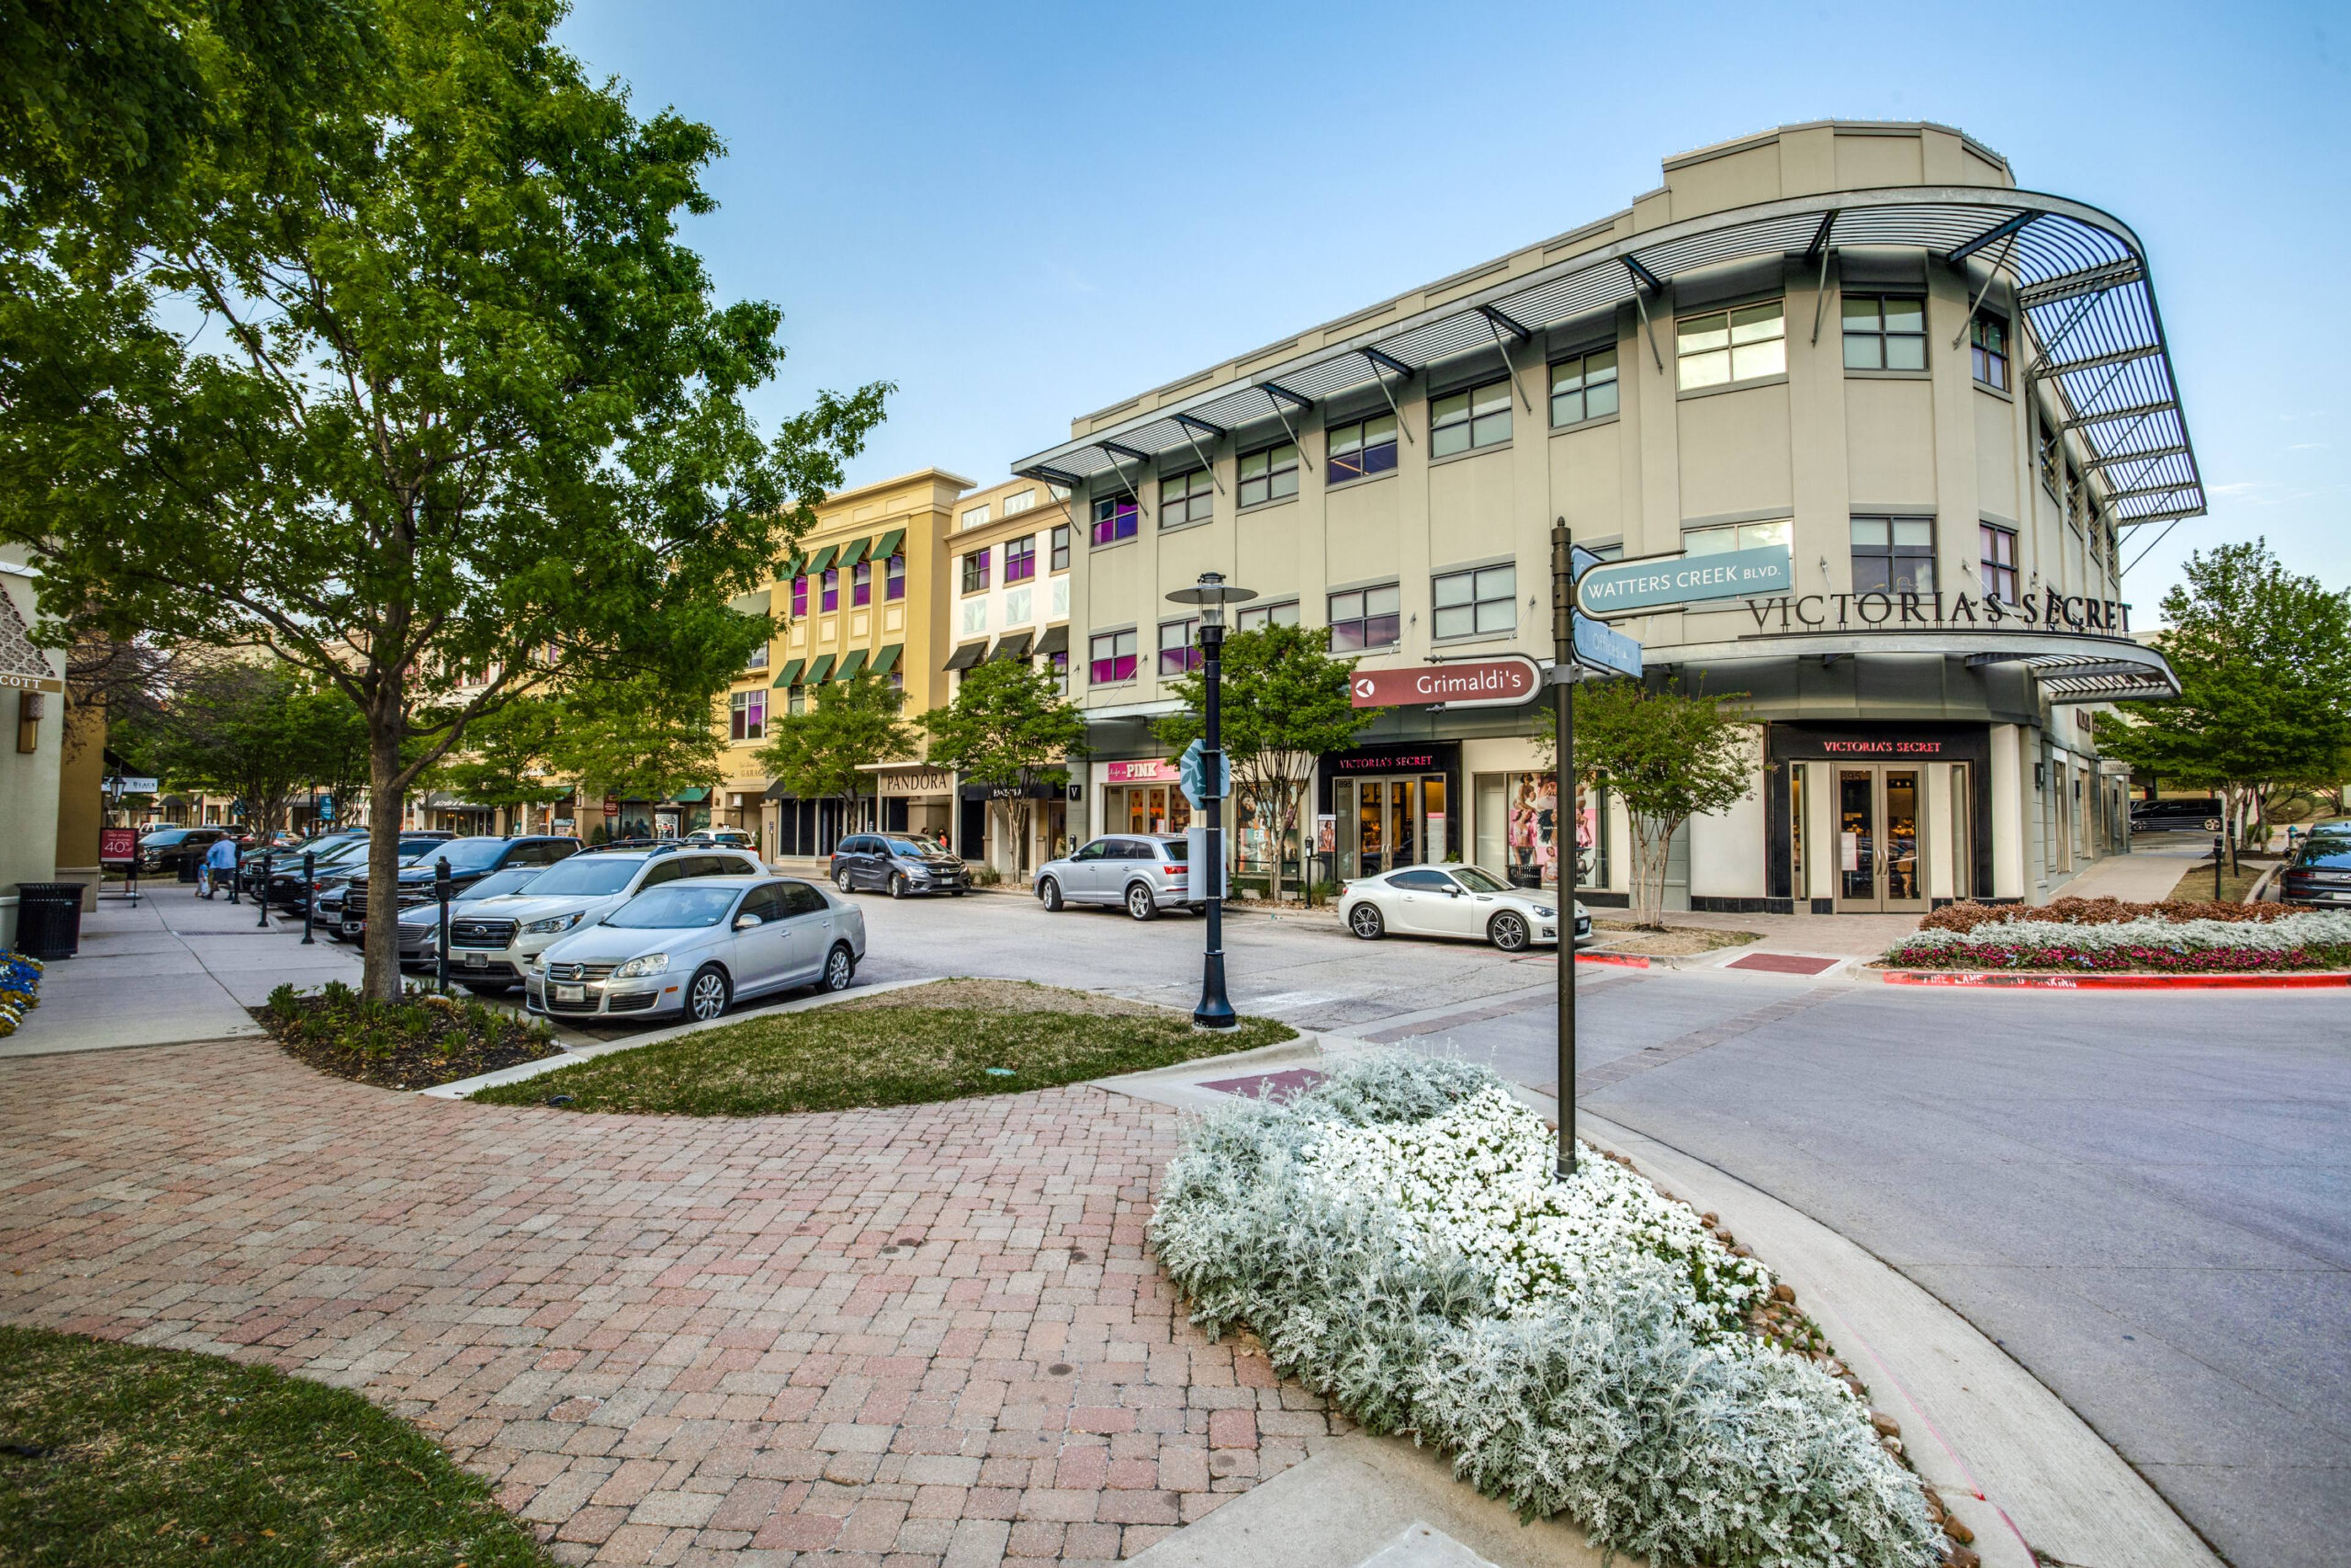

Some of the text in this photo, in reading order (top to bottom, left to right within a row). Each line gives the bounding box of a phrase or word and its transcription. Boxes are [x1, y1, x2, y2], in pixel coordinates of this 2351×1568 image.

[1587, 565, 1781, 599] WATTERS CREEK BLVD.
[2022, 593, 2132, 632] SECRET
[1593, 632, 1620, 658] Offices
[1416, 670, 1521, 694] Grimaldi's
[1823, 741, 1941, 752] VICTORIA'S SECRET
[1340, 756, 1433, 769] VICTORIA'S SECRET
[740, 769, 766, 778] GARAG
[1127, 762, 1157, 778] PINK
[887, 769, 947, 790] PANDORA
[1338, 780, 1352, 789] 895
[1071, 787, 1078, 797] V
[1954, 974, 1984, 985] LANE
